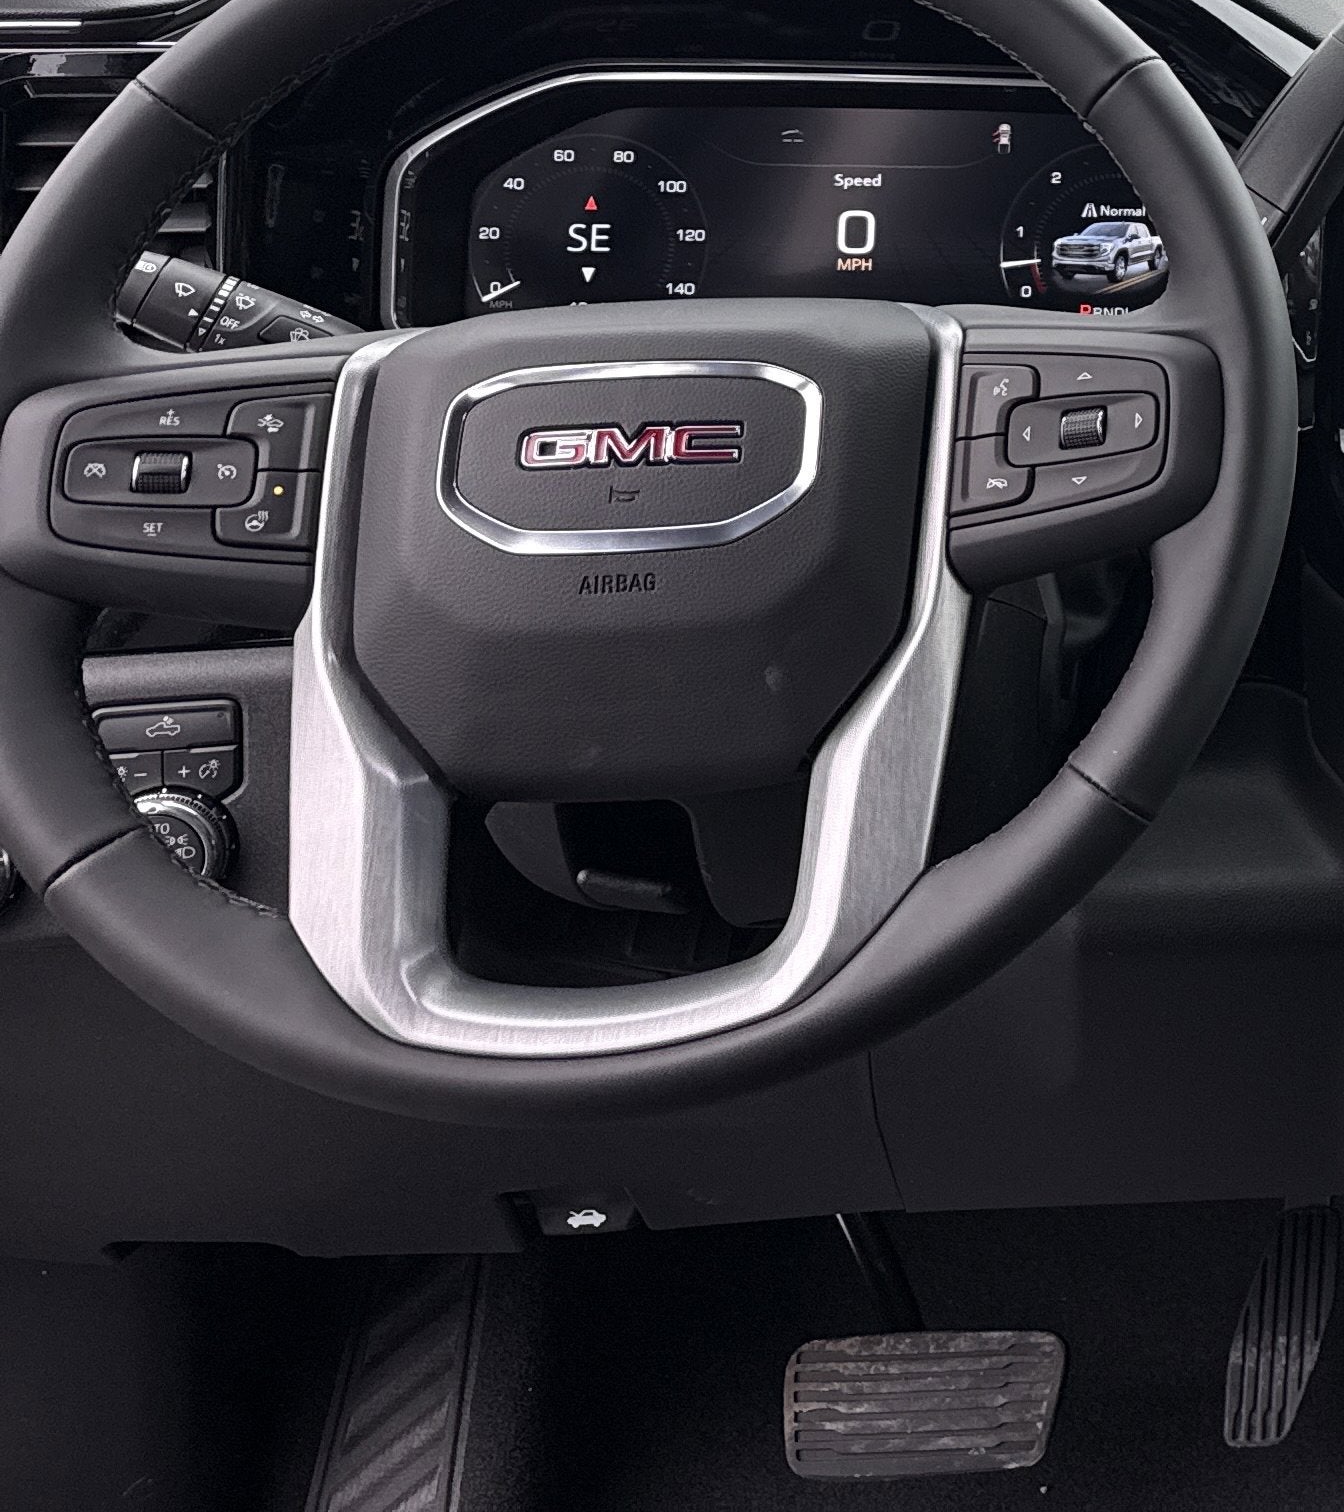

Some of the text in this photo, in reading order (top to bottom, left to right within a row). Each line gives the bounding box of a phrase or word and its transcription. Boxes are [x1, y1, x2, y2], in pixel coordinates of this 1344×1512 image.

[553, 149, 575, 162] 60
[613, 150, 635, 163] 80
[503, 177, 525, 191] 40
[833, 173, 883, 190] Speed
[1050, 171, 1062, 184] 2
[657, 180, 687, 194] 100
[1099, 204, 1147, 218] Normal
[478, 227, 500, 240] 20
[566, 223, 611, 253] SE
[676, 229, 706, 242] 120
[836, 209, 877, 255] 0
[1016, 226, 1024, 239] 1
[836, 257, 873, 272] MPH
[489, 281, 501, 294] 0
[665, 282, 695, 296] 140
[1020, 285, 1032, 298] 0
[489, 299, 513, 310] MPH
[219, 315, 240, 330] OFF
[213, 333, 227, 345] 1x
[159, 416, 181, 426] RES
[519, 424, 743, 469] GMC
[142, 522, 163, 533] SET
[578, 572, 657, 596] AIRBAG
